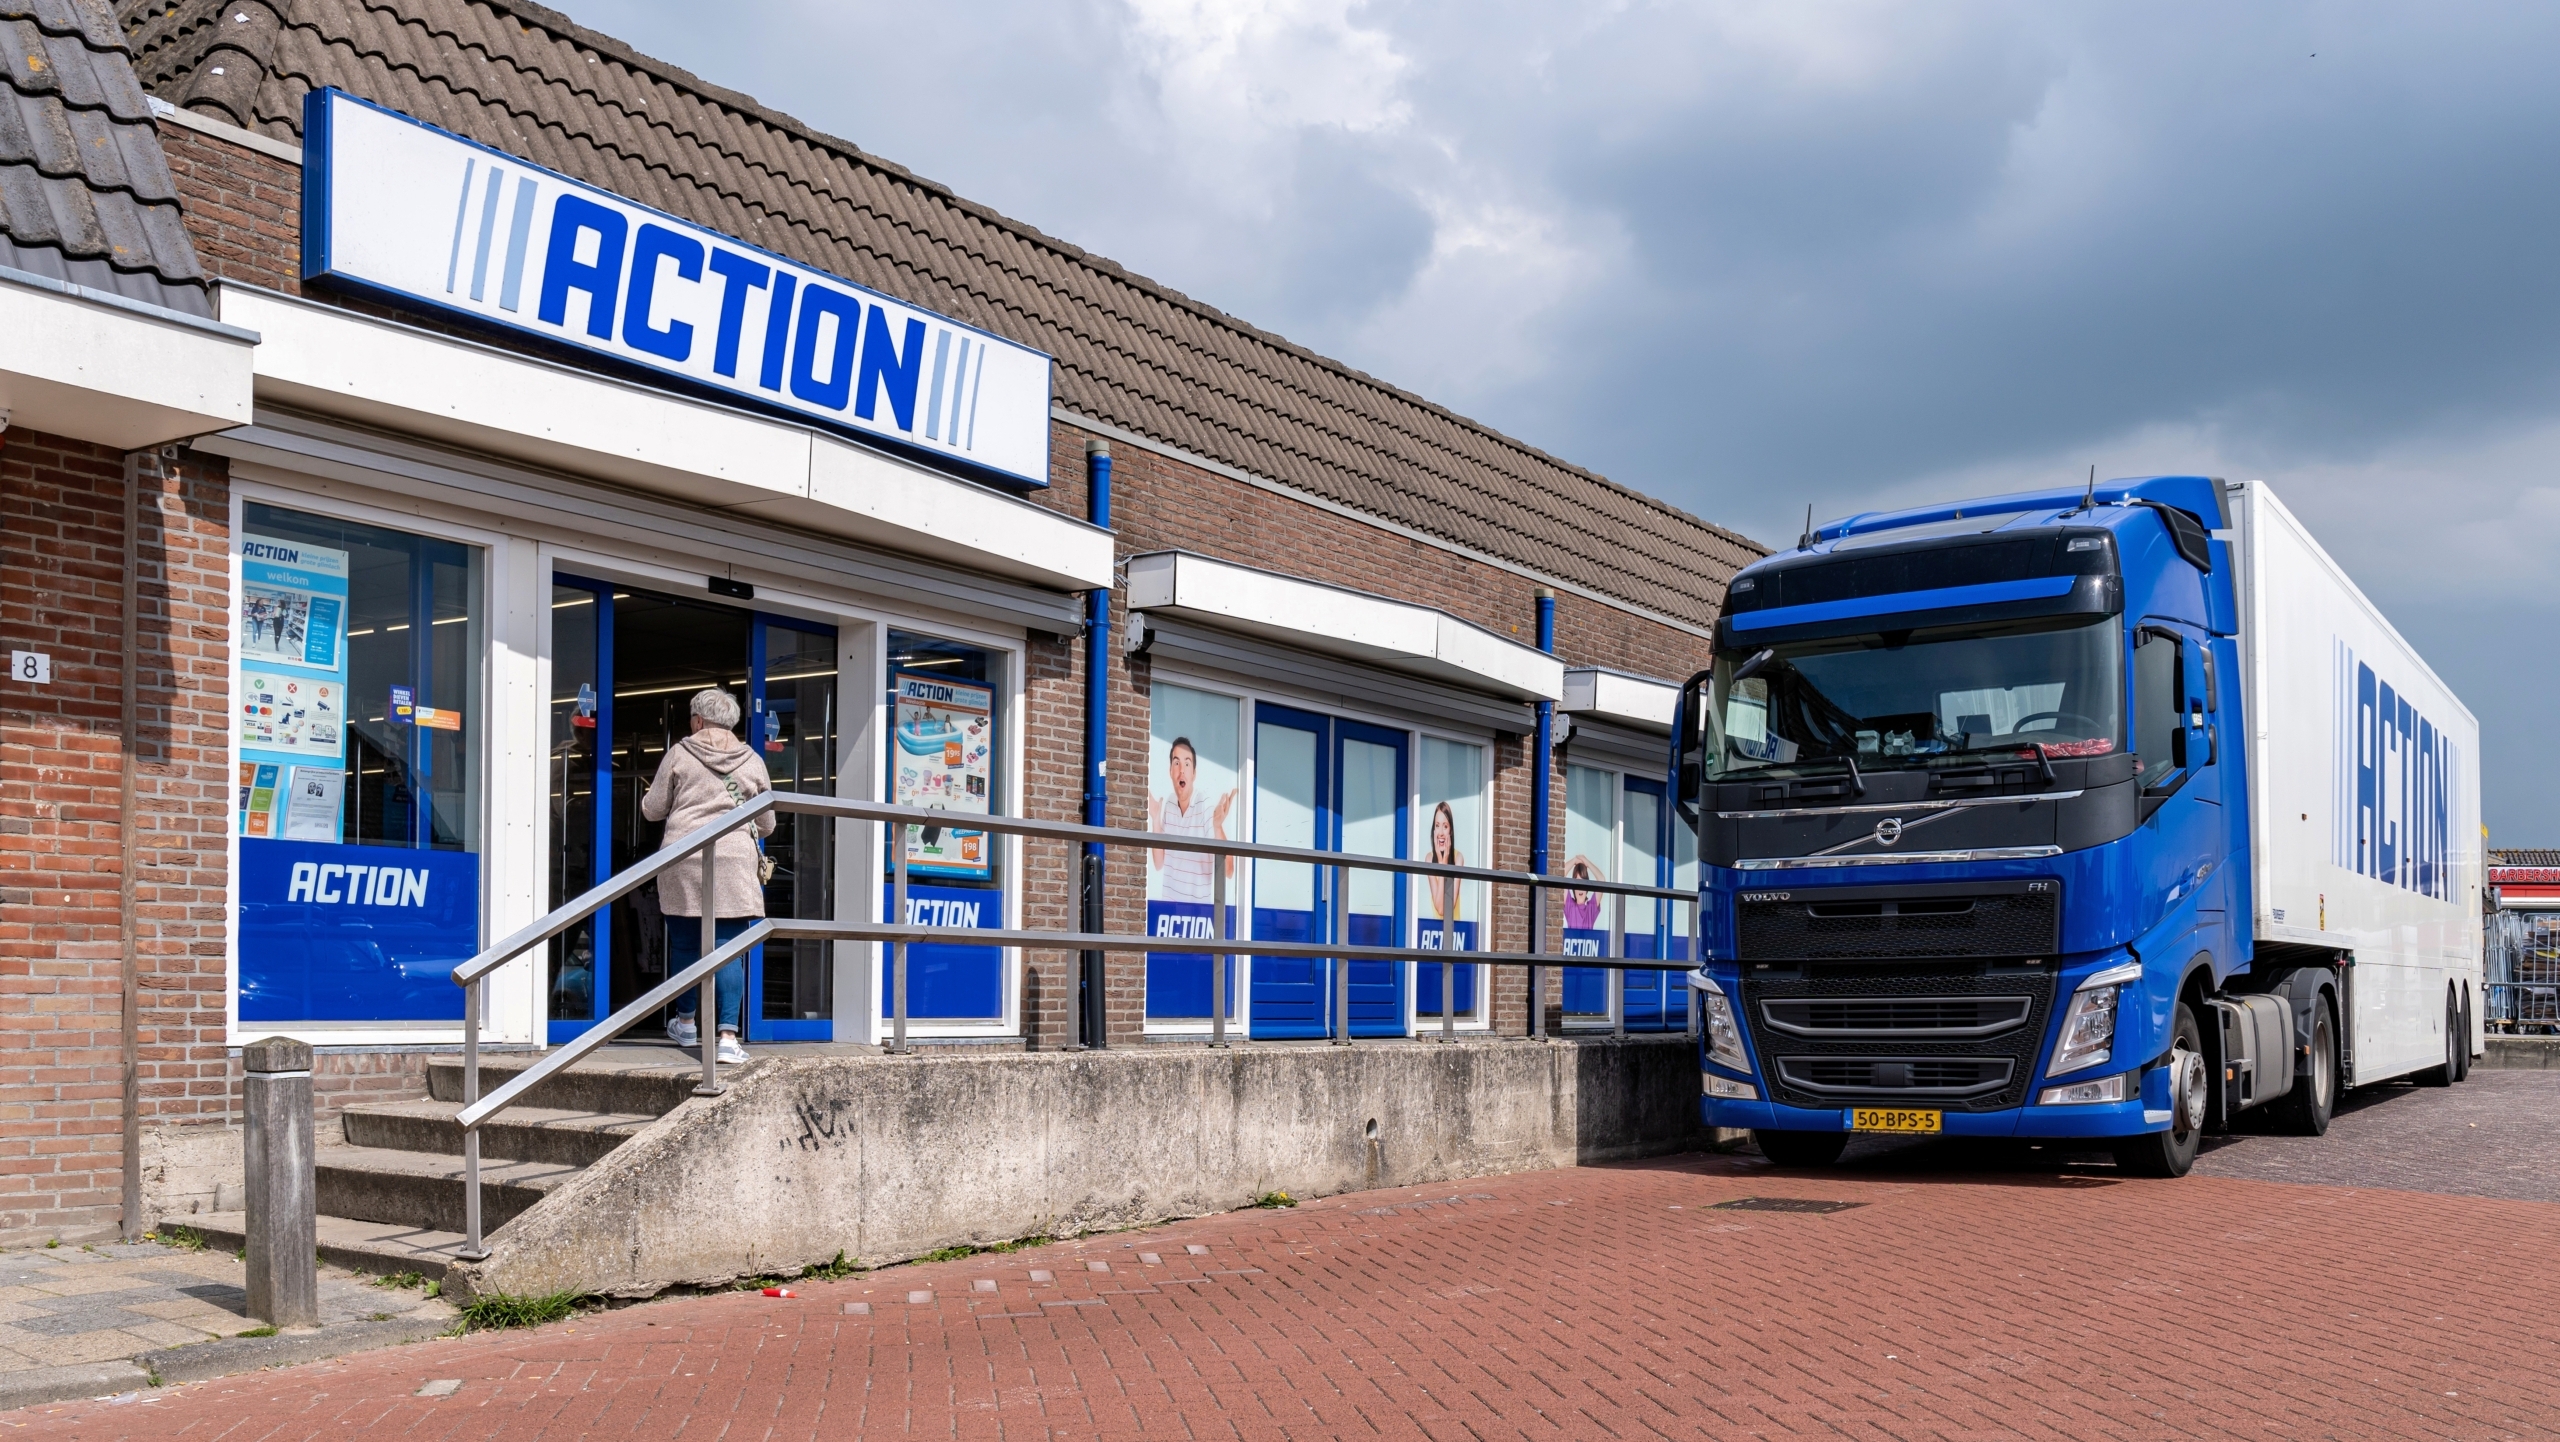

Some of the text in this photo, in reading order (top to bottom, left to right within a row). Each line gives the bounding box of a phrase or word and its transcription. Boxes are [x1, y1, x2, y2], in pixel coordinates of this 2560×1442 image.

[538, 194, 926, 433] ACTION
[242, 541, 299, 564] ACTION
[301, 551, 319, 560] kleine
[300, 559, 316, 567] grote
[267, 571, 309, 586] welkom
[23, 656, 38, 679] 8
[907, 681, 954, 702] ACTION
[955, 689, 970, 698] kleine
[2357, 659, 2448, 902] ACTION
[288, 862, 429, 907] ACTION
[2028, 882, 2048, 891] FH
[1741, 892, 1791, 902] VOLVO
[1421, 930, 1465, 951] ACTN
[1563, 938, 1600, 957] ACTION
[1858, 1112, 1935, 1128] 50-BPS-5
